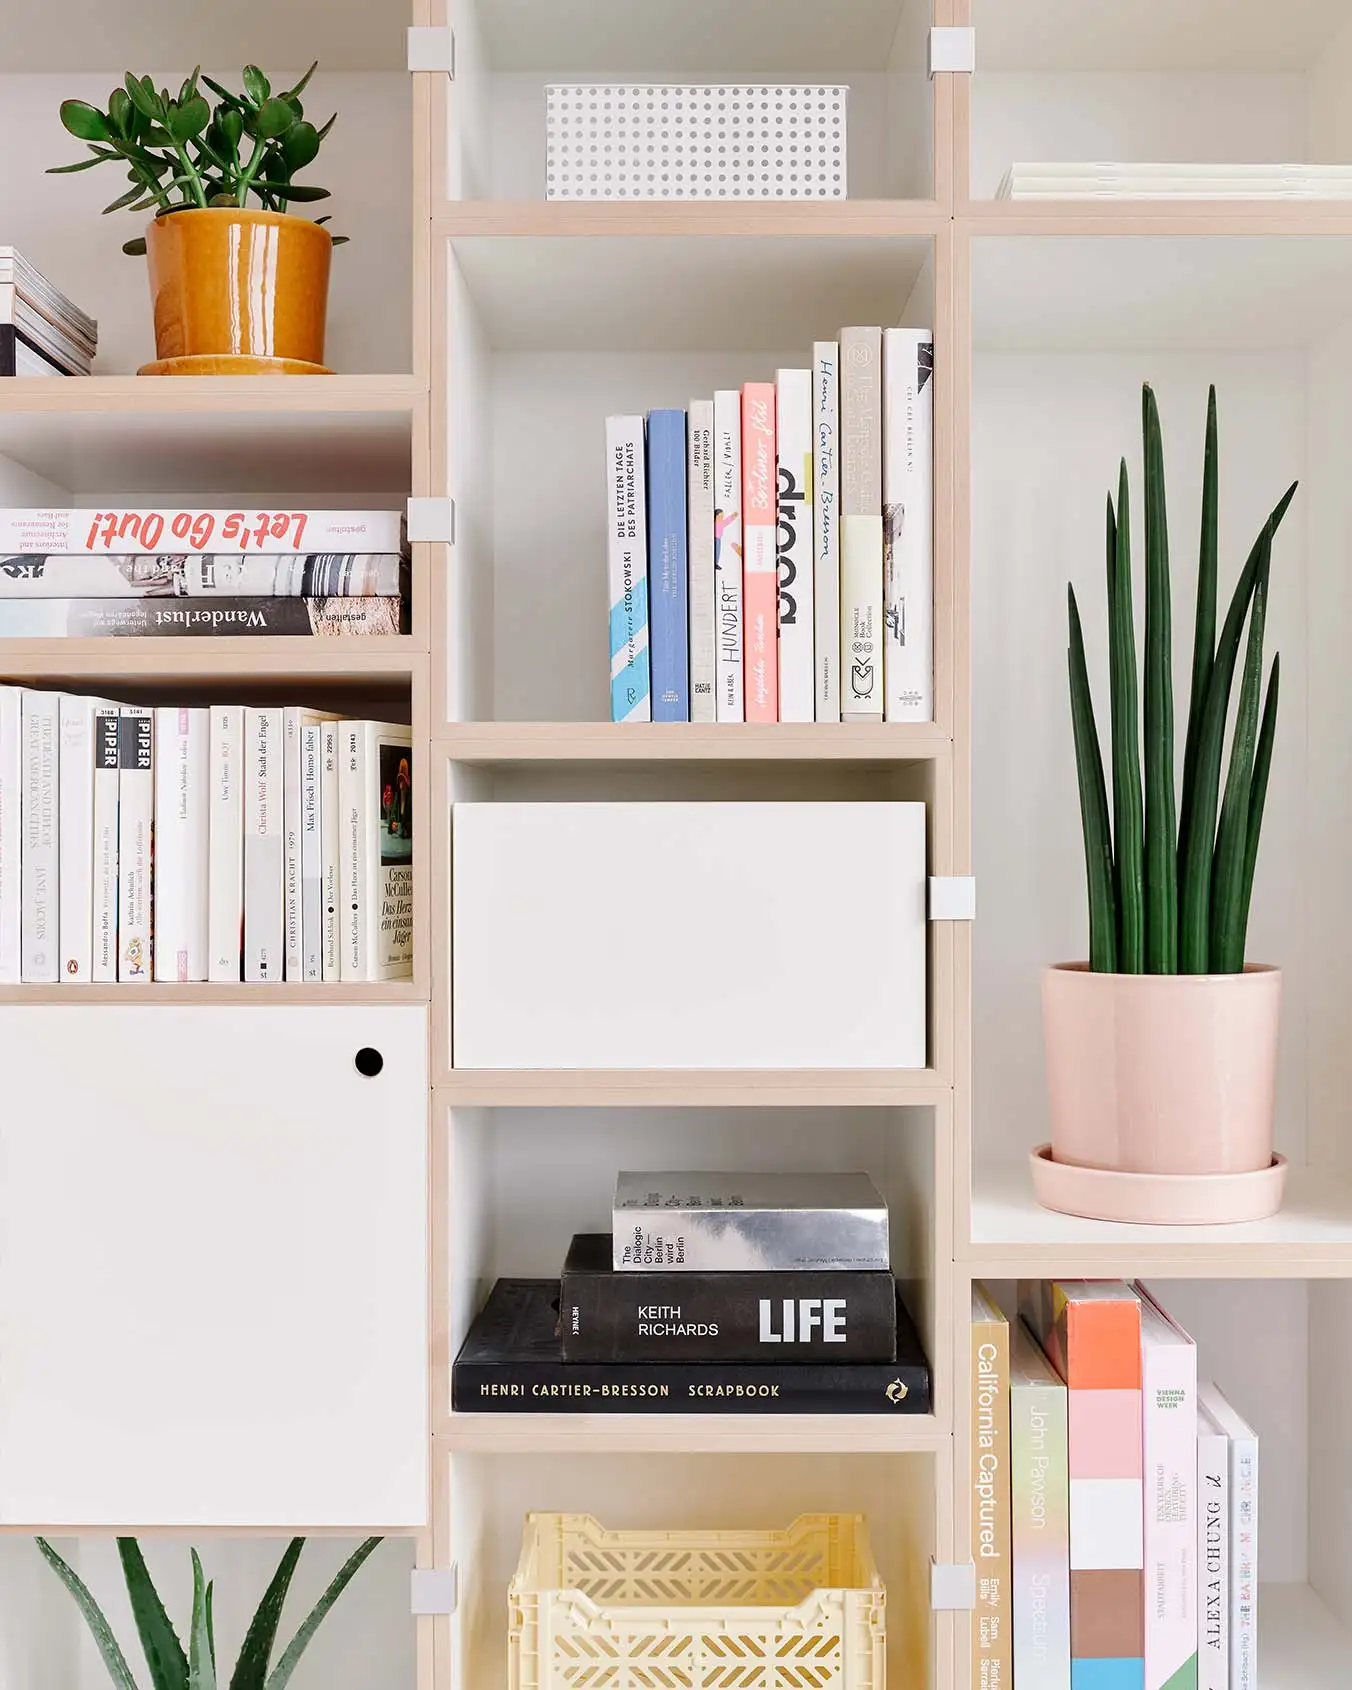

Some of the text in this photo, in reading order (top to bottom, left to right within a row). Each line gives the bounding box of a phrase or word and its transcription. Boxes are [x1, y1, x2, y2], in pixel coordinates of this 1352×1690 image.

[820, 360, 834, 413] Henri
[693, 429, 701, 467] 100 Bilder
[703, 429, 711, 461] Gerhard
[748, 437, 768, 511] Berliner
[614, 445, 626, 538] DIE LETZTEN TAGE
[625, 441, 636, 538] DES PATRIARCHATS
[86, 512, 309, 550] Let's Go Out!
[326, 524, 367, 535] gestalten
[623, 551, 633, 613] STOKOWSKI
[155, 610, 267, 628] Wanderlust
[325, 612, 367, 625] gestalten
[721, 580, 740, 663] HUNDERT
[104, 721, 117, 766] PIPER
[137, 722, 151, 767] PIPER
[258, 715, 269, 834] Christa Wolf Stadt der Engel
[304, 730, 315, 832] Max Frisch Homo faber
[221, 786, 229, 801] Uwe
[288, 831, 297, 948] CHRISTIAN KRACHT 1979
[326, 865, 334, 890] Vorleser
[326, 890, 334, 903] Der
[350, 889, 358, 901] Das
[382, 900, 396, 916] Das
[350, 913, 358, 945] McCullers
[381, 917, 392, 931] ein
[392, 929, 411, 947] Jäger
[326, 940, 335, 968] Bernhard
[350, 946, 358, 968] Carson
[622, 1246, 631, 1264] The
[633, 1226, 643, 1264] Dialogic
[654, 1237, 663, 1263] Berlin
[665, 1243, 674, 1264] wird
[675, 1236, 685, 1263] Berlin
[638, 1305, 681, 1320] KEITH
[758, 1299, 847, 1343] LIFE
[638, 1322, 719, 1337] RICHARDS
[480, 1383, 526, 1397] HENRI
[689, 1385, 780, 1398] SCRAPBOOK
[975, 1343, 1000, 1558] California Captured
[1028, 1405, 1051, 1664] John Pawson Spectrum
[979, 1578, 990, 1600] Bills
[1205, 1501, 1221, 1650] ALEXA CHUNG
[986, 1578, 1001, 1608] Emily
[979, 1616, 990, 1648] Lubell
[989, 1616, 1000, 1640] Sam
